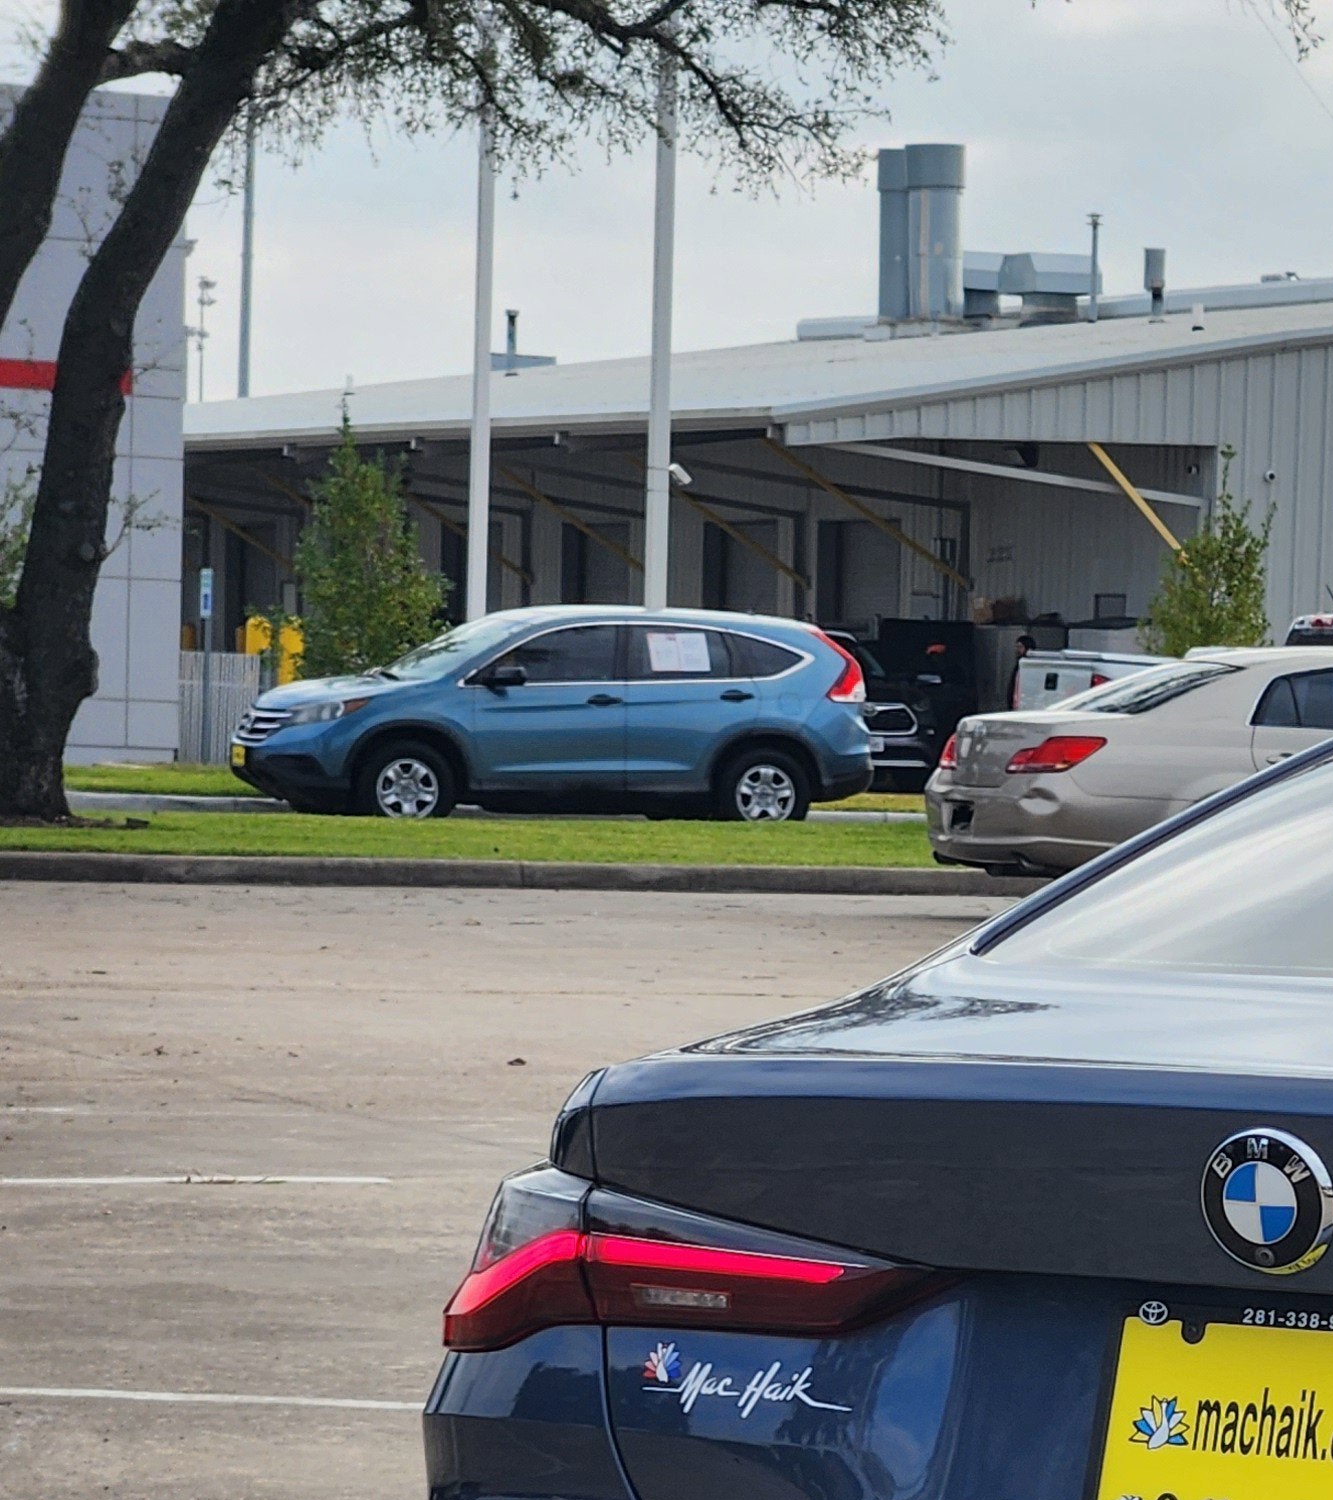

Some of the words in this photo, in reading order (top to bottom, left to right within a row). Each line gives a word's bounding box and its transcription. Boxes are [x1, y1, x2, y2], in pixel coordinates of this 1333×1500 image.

[1211, 1136, 1312, 1184] BMW
[680, 1361, 740, 1414] Mac
[737, 1361, 828, 1419] Haik
